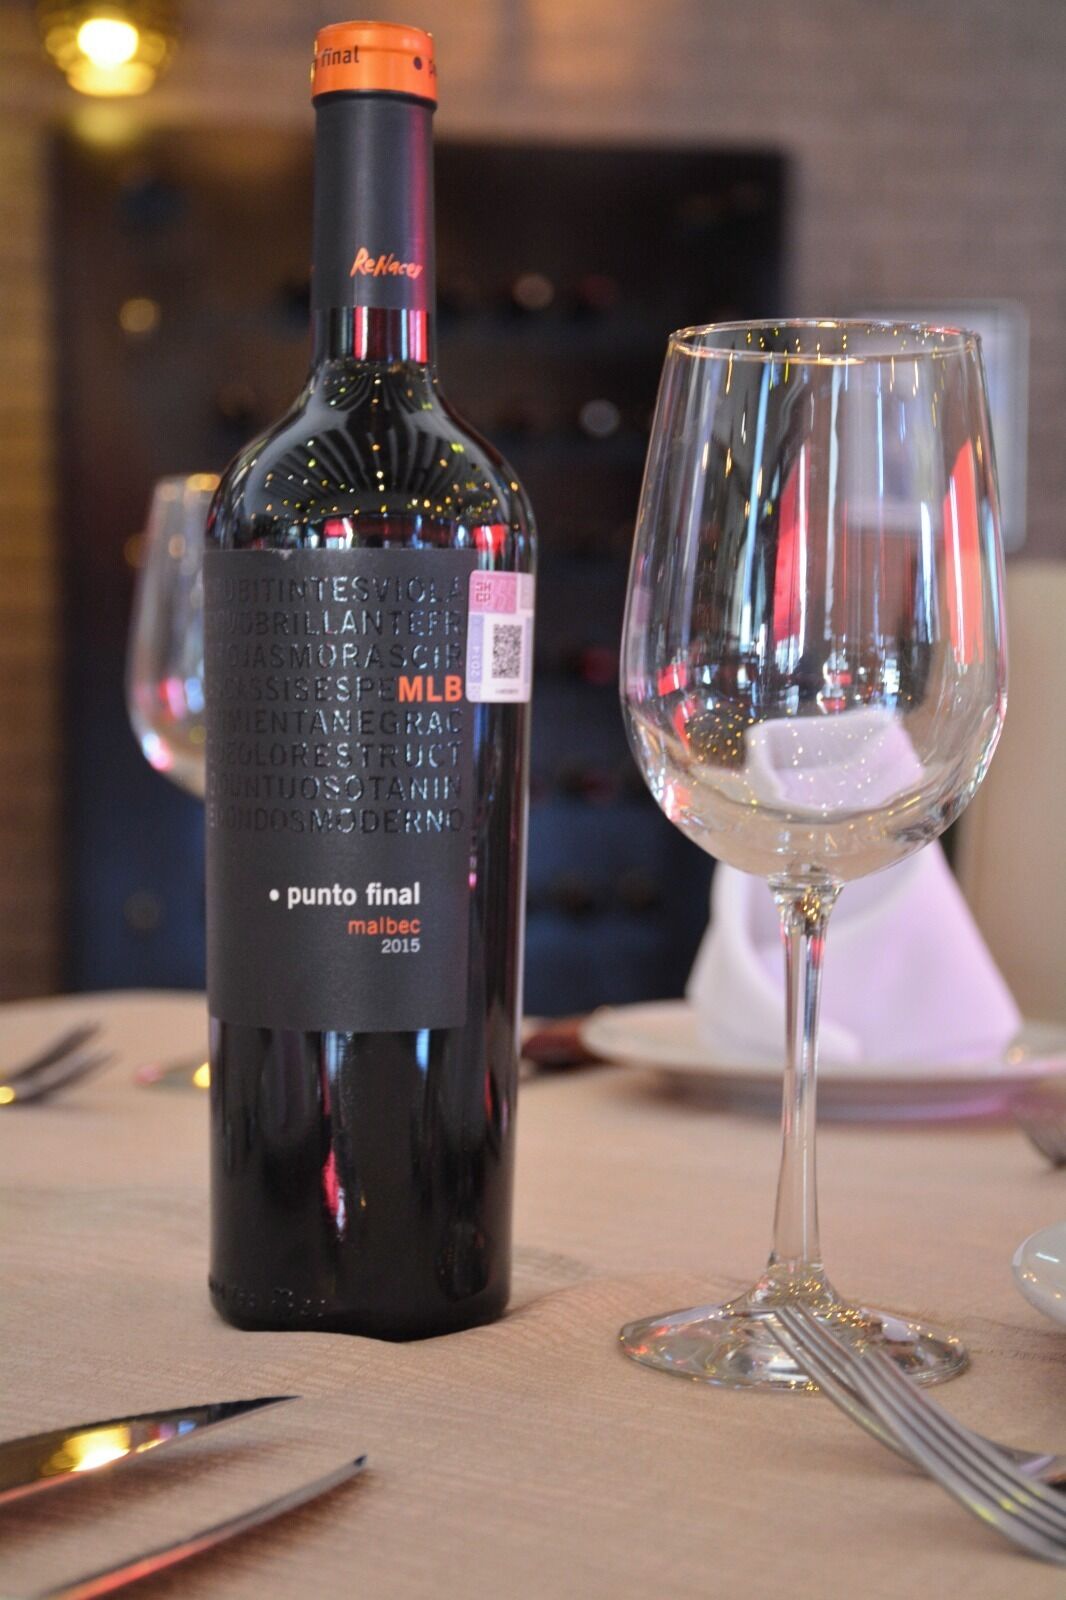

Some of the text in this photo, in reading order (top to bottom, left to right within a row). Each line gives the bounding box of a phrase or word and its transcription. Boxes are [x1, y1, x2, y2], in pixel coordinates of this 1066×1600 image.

[320, 45, 360, 67] final
[287, 881, 420, 909] punto final
[348, 916, 421, 935] malbec
[381, 938, 421, 954] 2015
